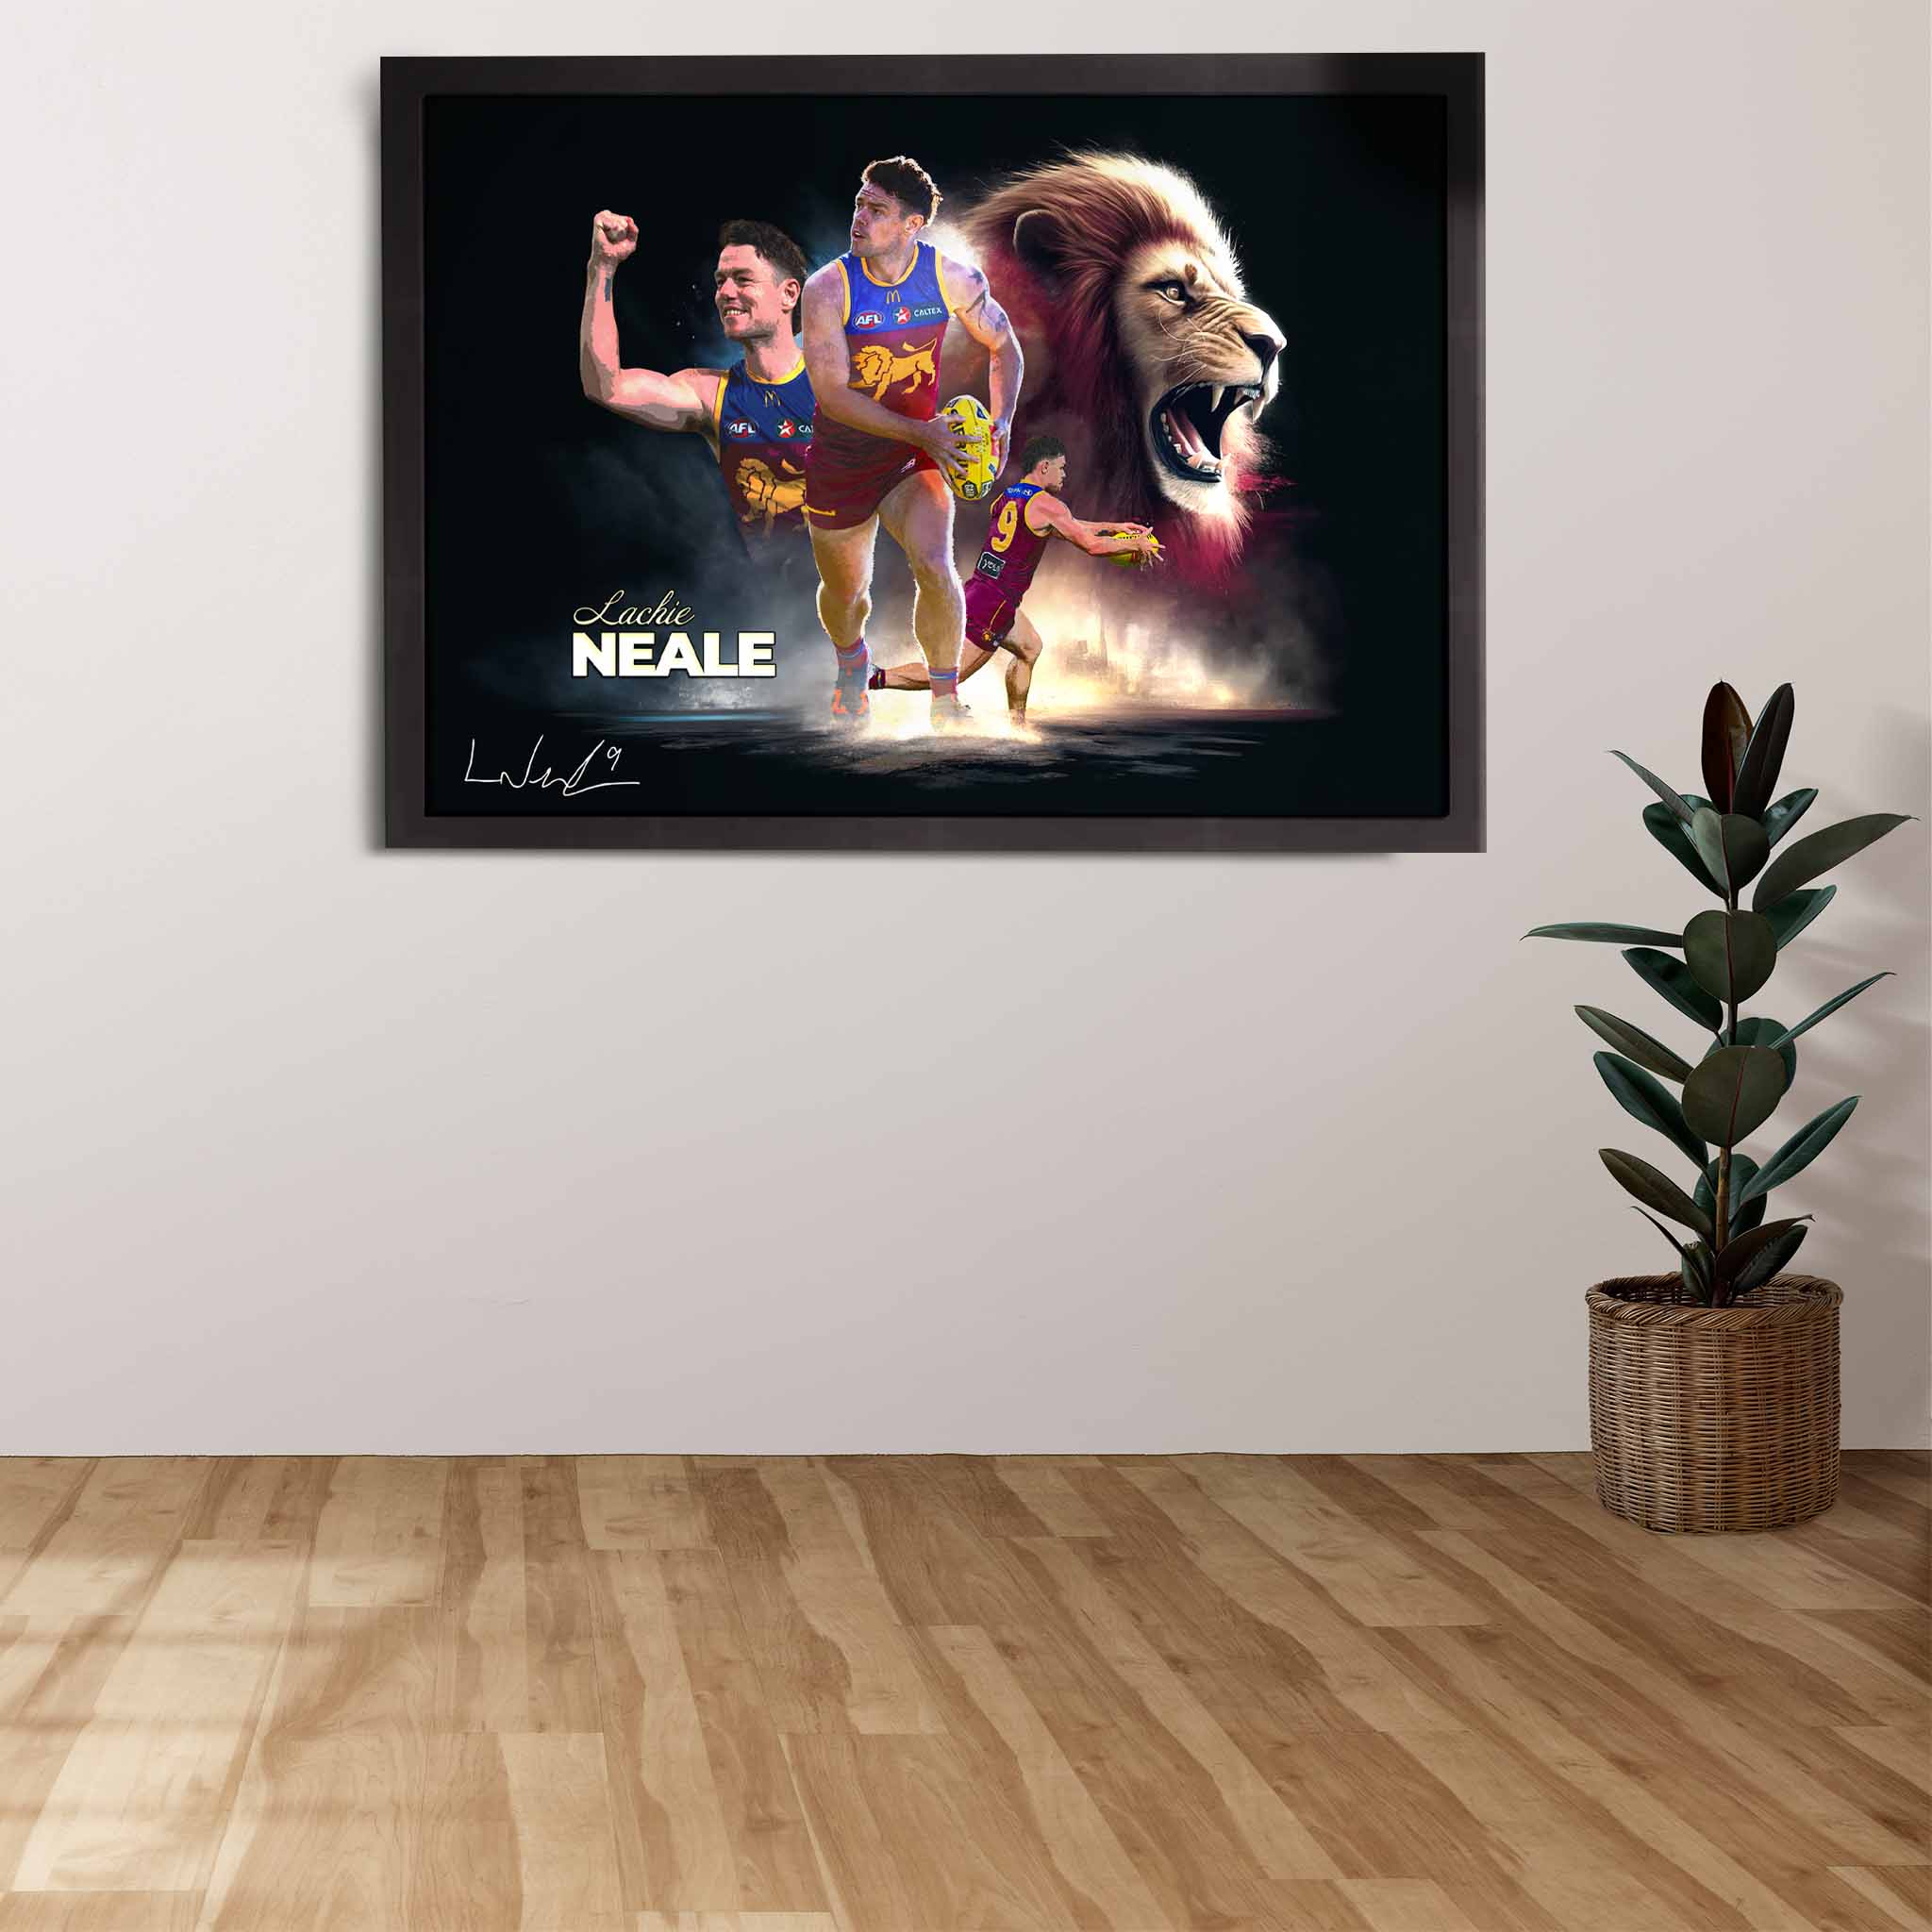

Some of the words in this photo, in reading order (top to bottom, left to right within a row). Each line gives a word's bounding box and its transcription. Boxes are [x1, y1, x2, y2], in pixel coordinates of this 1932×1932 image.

[855, 314, 882, 326] AFL
[913, 307, 943, 318] CALTEX
[728, 422, 757, 435] AFL
[991, 500, 1018, 553] 9
[573, 589, 695, 626] Lachie
[572, 631, 777, 678] NEALE
